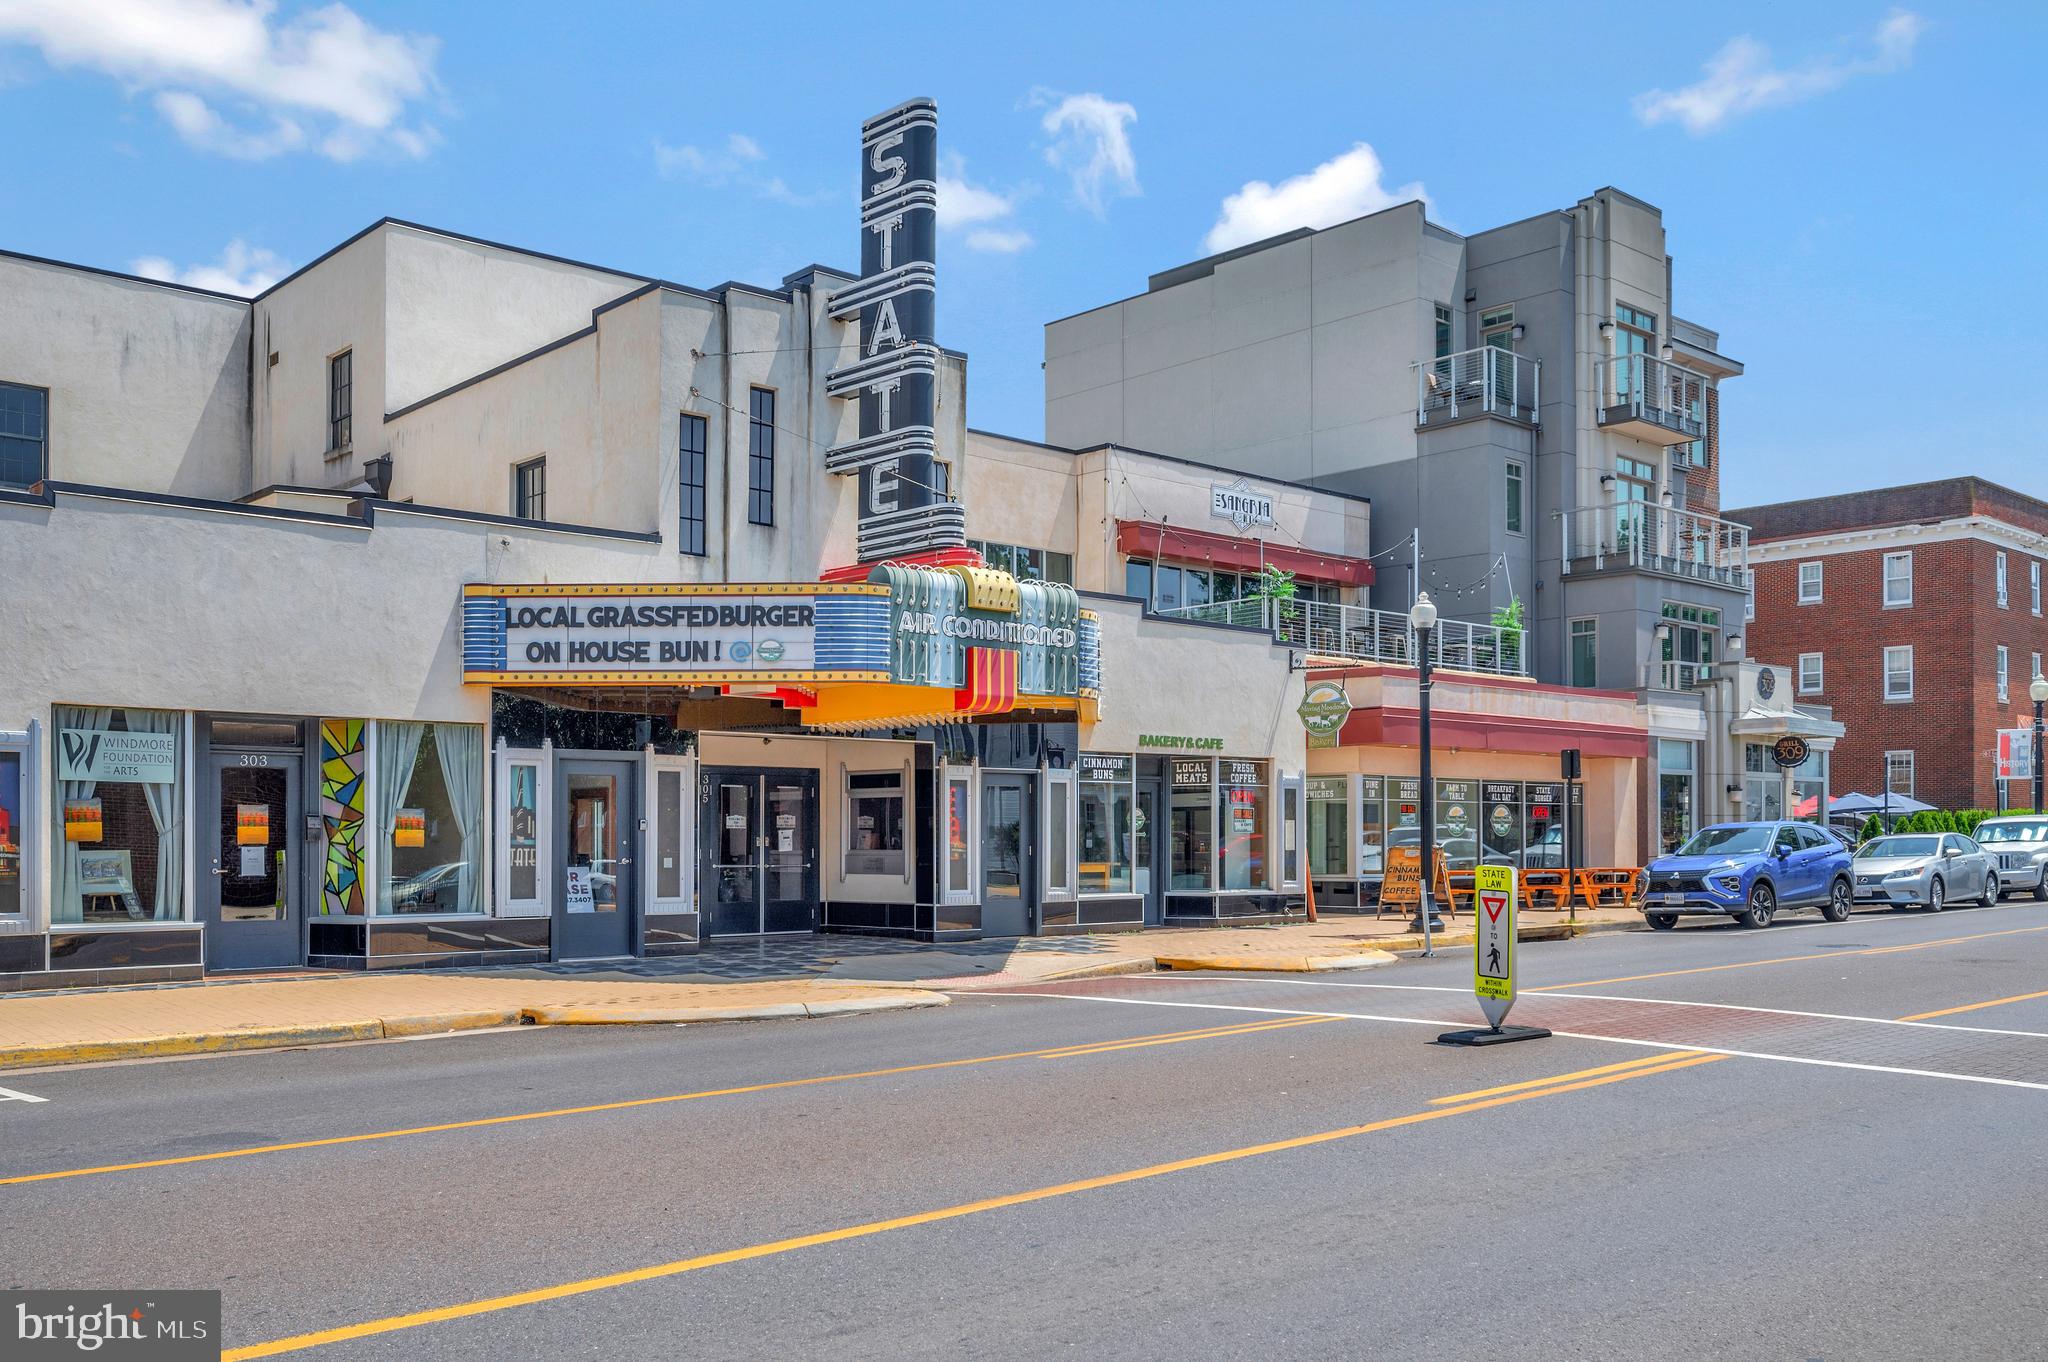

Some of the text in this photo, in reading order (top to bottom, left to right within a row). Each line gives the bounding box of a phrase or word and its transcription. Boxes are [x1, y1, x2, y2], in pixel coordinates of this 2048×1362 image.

[868, 133, 908, 515] STATE
[1220, 493, 1270, 517] SANGRIA
[506, 606, 584, 629] LOCAL
[898, 610, 1077, 648] AIR CONDITIONED
[525, 641, 561, 663] ON
[569, 640, 651, 663] HOUSE
[103, 737, 173, 751] WINDMORE
[1780, 740, 1800, 748] GRILL
[1777, 745, 1804, 760] 309
[103, 752, 173, 764] FOUNDATION
[239, 755, 268, 767] 303
[1082, 757, 1123, 769] CINNAMON
[112, 766, 139, 776] ARTS
[1175, 762, 1207, 773] LOCAL
[1231, 762, 1255, 773] FRESH
[1092, 769, 1114, 780] BUNS
[1175, 773, 1208, 784] MEATS
[1230, 773, 1257, 784] COFFEE
[702, 774, 710, 804] 305
[1306, 781, 1326, 790] OUP &
[1365, 781, 1379, 789] DINE
[1400, 782, 1418, 791] FRESH
[1445, 783, 1468, 793] FARM TO
[1487, 784, 1515, 794] BREAKFAST
[1306, 790, 1334, 799] DWICHES
[1368, 789, 1376, 798] IN
[1400, 790, 1418, 799] BREAD
[1448, 792, 1465, 800] TABLE
[1536, 787, 1551, 795] STATE
[1231, 789, 1256, 804] OPEN
[1491, 792, 1512, 801] ALL DAY
[1535, 795, 1553, 803] BURGER
[511, 848, 536, 867] TATE
[1387, 866, 1420, 874] CINNAM
[1482, 869, 1506, 880] STATE
[1396, 874, 1421, 882] BUNS
[1485, 879, 1502, 889] LAW
[1384, 887, 1417, 895] COFFEE
[568, 896, 592, 904] 7.3407
[1490, 932, 1498, 940] TO
[1485, 979, 1503, 987] WITHIN
[1478, 986, 1509, 997] CROSSWALK
